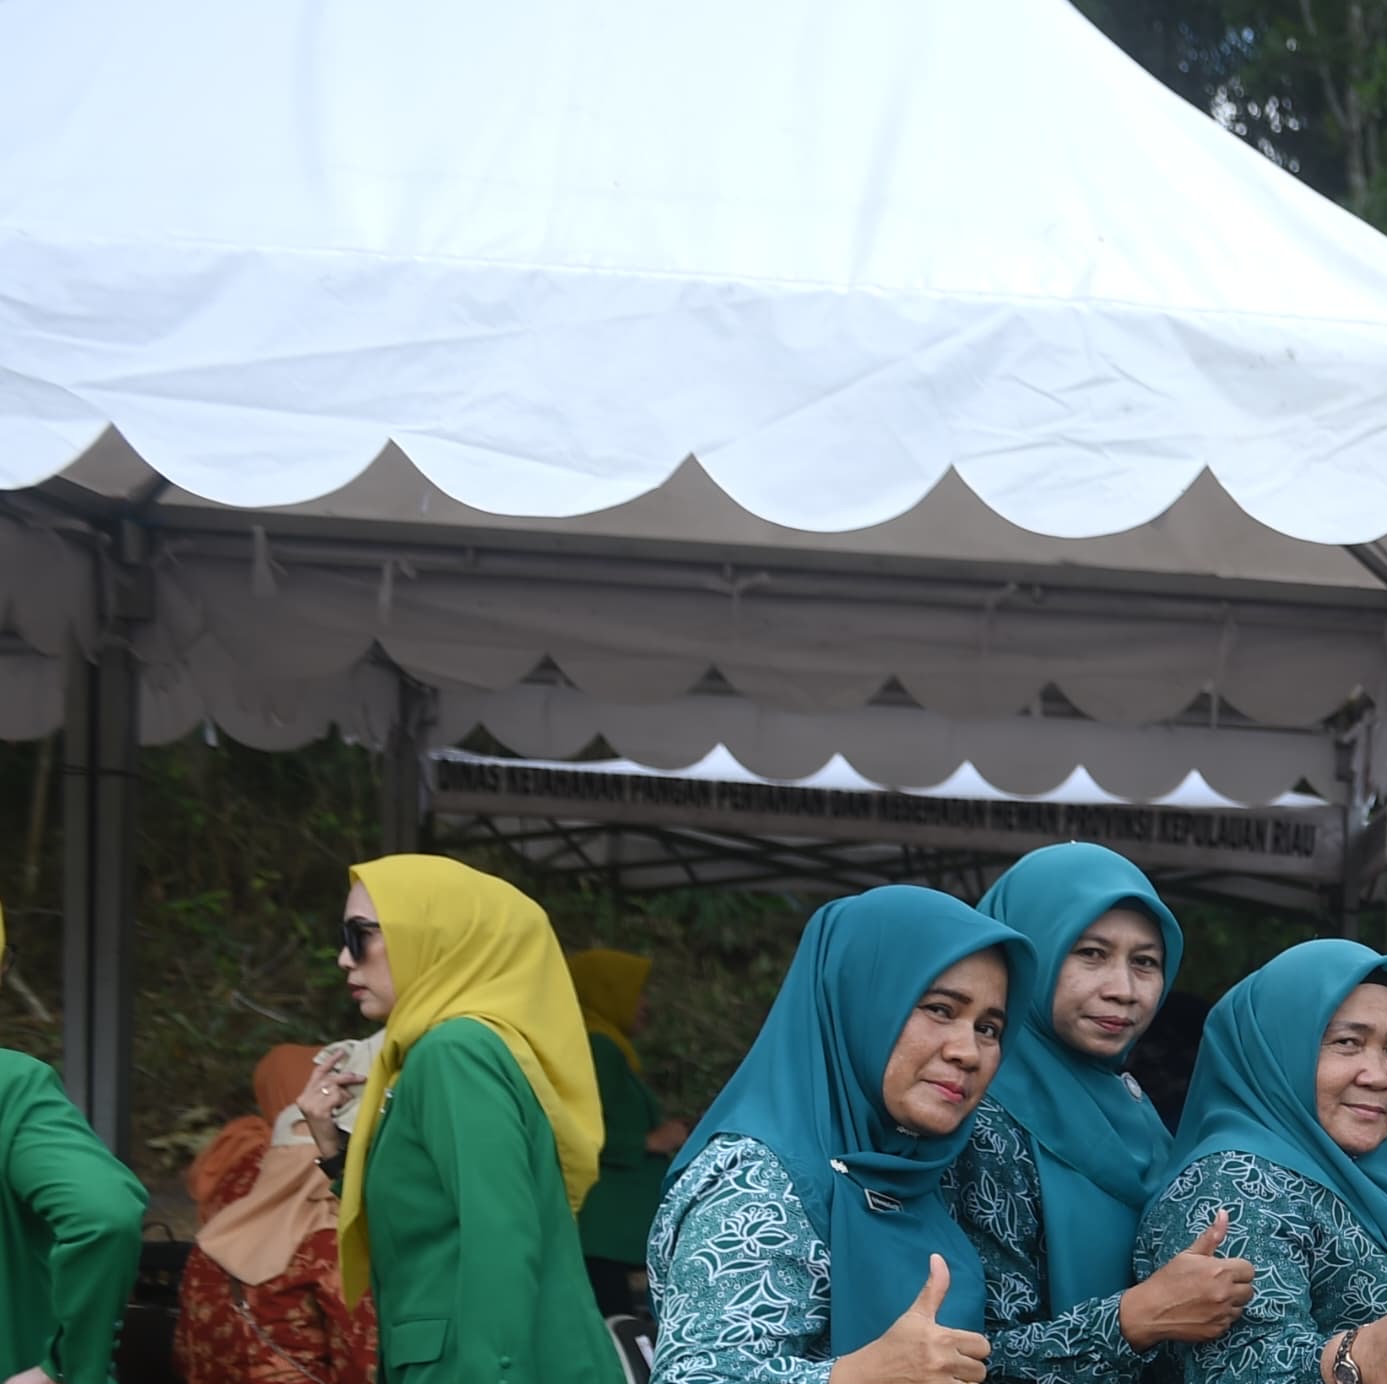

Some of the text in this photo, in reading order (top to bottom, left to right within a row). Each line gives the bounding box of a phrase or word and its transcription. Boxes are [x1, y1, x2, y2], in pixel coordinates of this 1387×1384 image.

[1064, 804, 1154, 843] PROVINSI
[1158, 811, 1267, 852] KEPULAUAN
[1270, 819, 1316, 858] RIAU
